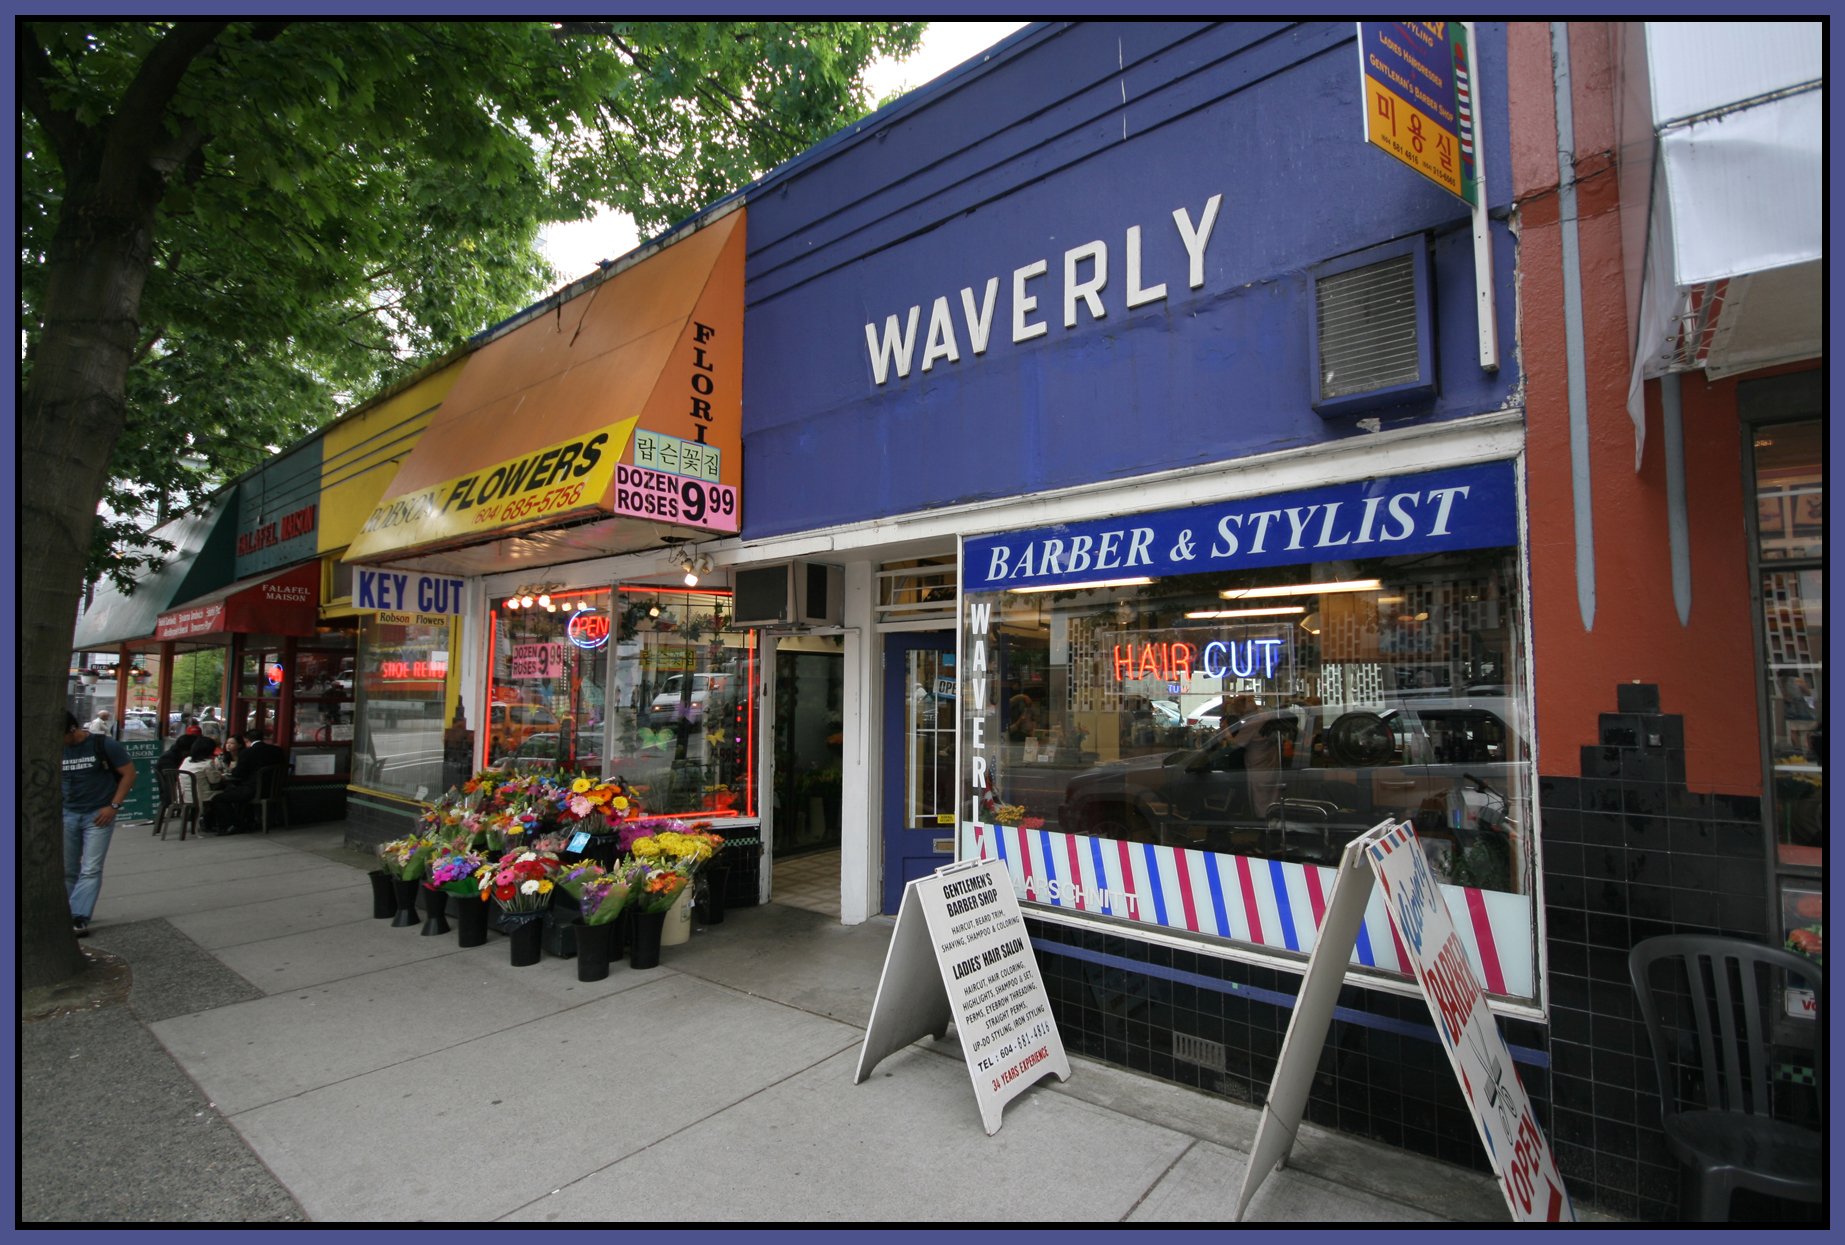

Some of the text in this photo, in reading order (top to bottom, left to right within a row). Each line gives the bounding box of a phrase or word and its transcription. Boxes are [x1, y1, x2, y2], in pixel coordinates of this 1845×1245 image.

[1402, 22, 1434, 47] TYLING
[1379, 31, 1443, 88] LADIES HAIRDRESSER
[1369, 53, 1454, 122] GENTLEMAN'S BARBER SHOP
[865, 193, 1222, 385] WAVERLY
[690, 321, 715, 445] FLORI
[438, 433, 609, 515] FLOWERS
[617, 465, 679, 494] DOZEN
[472, 481, 586, 525] (604) 685-5758
[617, 488, 678, 517] ROSES
[237, 522, 278, 557] ALAFEL
[984, 486, 1470, 582] BARBER & STYLIST
[262, 584, 311, 595] FALAFEL
[266, 592, 306, 602] MAISON
[359, 571, 464, 614] KEY CUT
[380, 612, 444, 625] Robson Flowers
[571, 616, 610, 637] OPEN
[513, 660, 537, 674] ROSES
[514, 645, 538, 659] DOZEN
[1114, 640, 1281, 681] HAIR CUT
[382, 661, 410, 678] SHOE
[939, 680, 956, 695] OPE
[126, 743, 158, 751] LAFEL
[970, 603, 991, 860] WAVERLY
[943, 873, 993, 899] GENTLEMEN'S
[947, 888, 998, 917] BARBER SHOP
[1012, 875, 1139, 913] AARSCHNITT
[941, 935, 967, 952] SHAVING,
[967, 927, 991, 942] SHAMPOO
[996, 916, 1020, 932] COLORING
[951, 920, 976, 935] HAIRCUT,
[975, 913, 992, 927] BEARD
[952, 937, 1024, 980] LADIES' HAIR SALON
[962, 991, 995, 1011] HIGHLIGHTS,
[995, 978, 1019, 994] SHAMPOO
[964, 979, 989, 996] HAIRCUT,
[988, 972, 1000, 984] HAIR
[1427, 931, 1484, 1047] BARBER
[965, 1009, 986, 1024] PERMS,
[985, 996, 1009, 1014] EYEBROW
[985, 1008, 1011, 1029] STRAIGHT
[972, 1004, 1045, 1052] UP-DO STYLING, IRON STYLING
[992, 1045, 1050, 1092] 34 YEARS EXPERIENCE
[1511, 1104, 1543, 1215] OPEN
